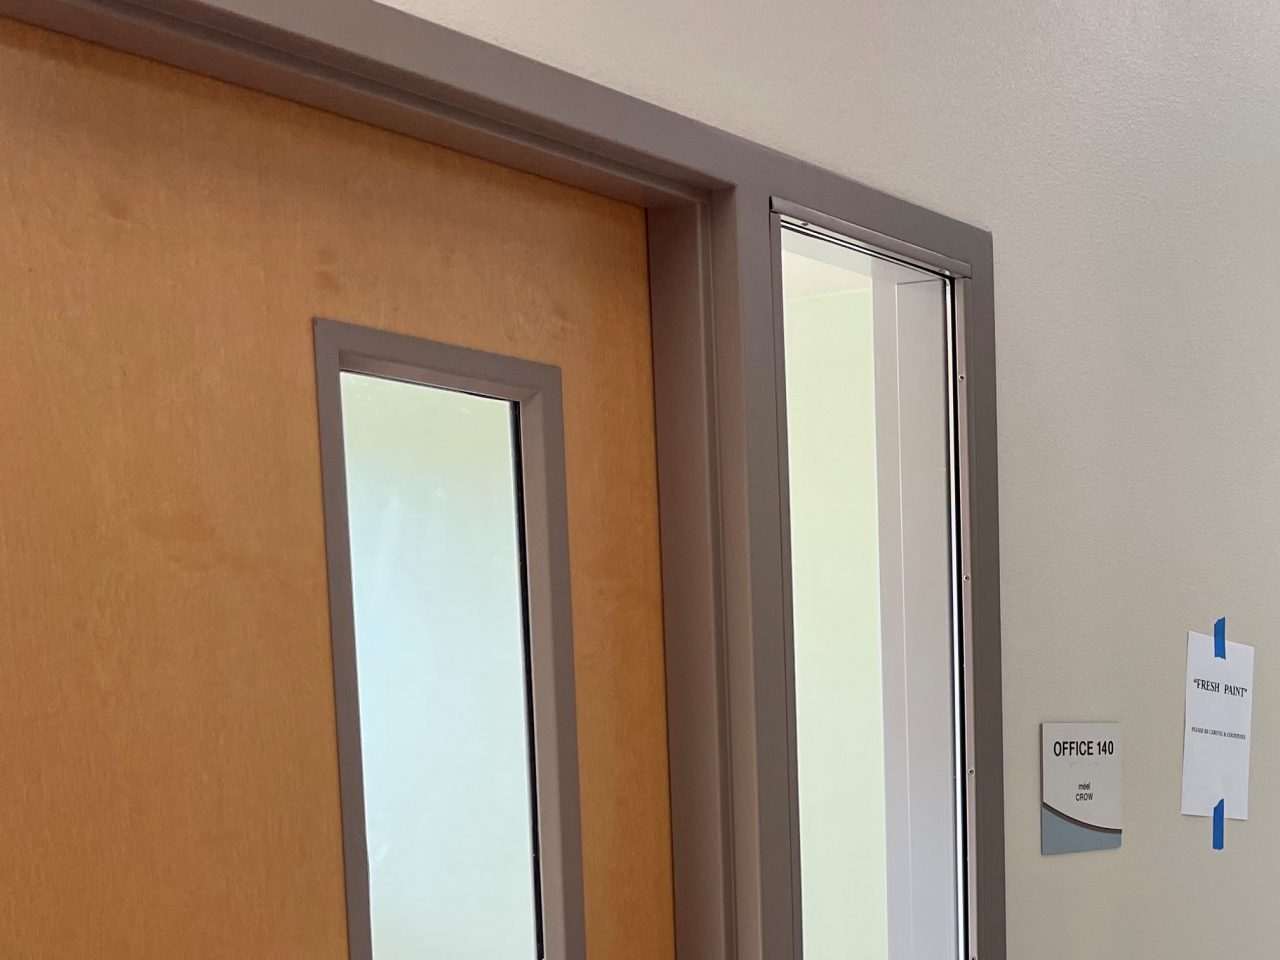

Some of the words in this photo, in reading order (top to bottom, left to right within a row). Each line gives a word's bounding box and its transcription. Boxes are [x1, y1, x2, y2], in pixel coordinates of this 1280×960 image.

[1053, 740, 1094, 757] OFFICE
[1096, 740, 1114, 756] 140
[1075, 792, 1094, 802] CROW
